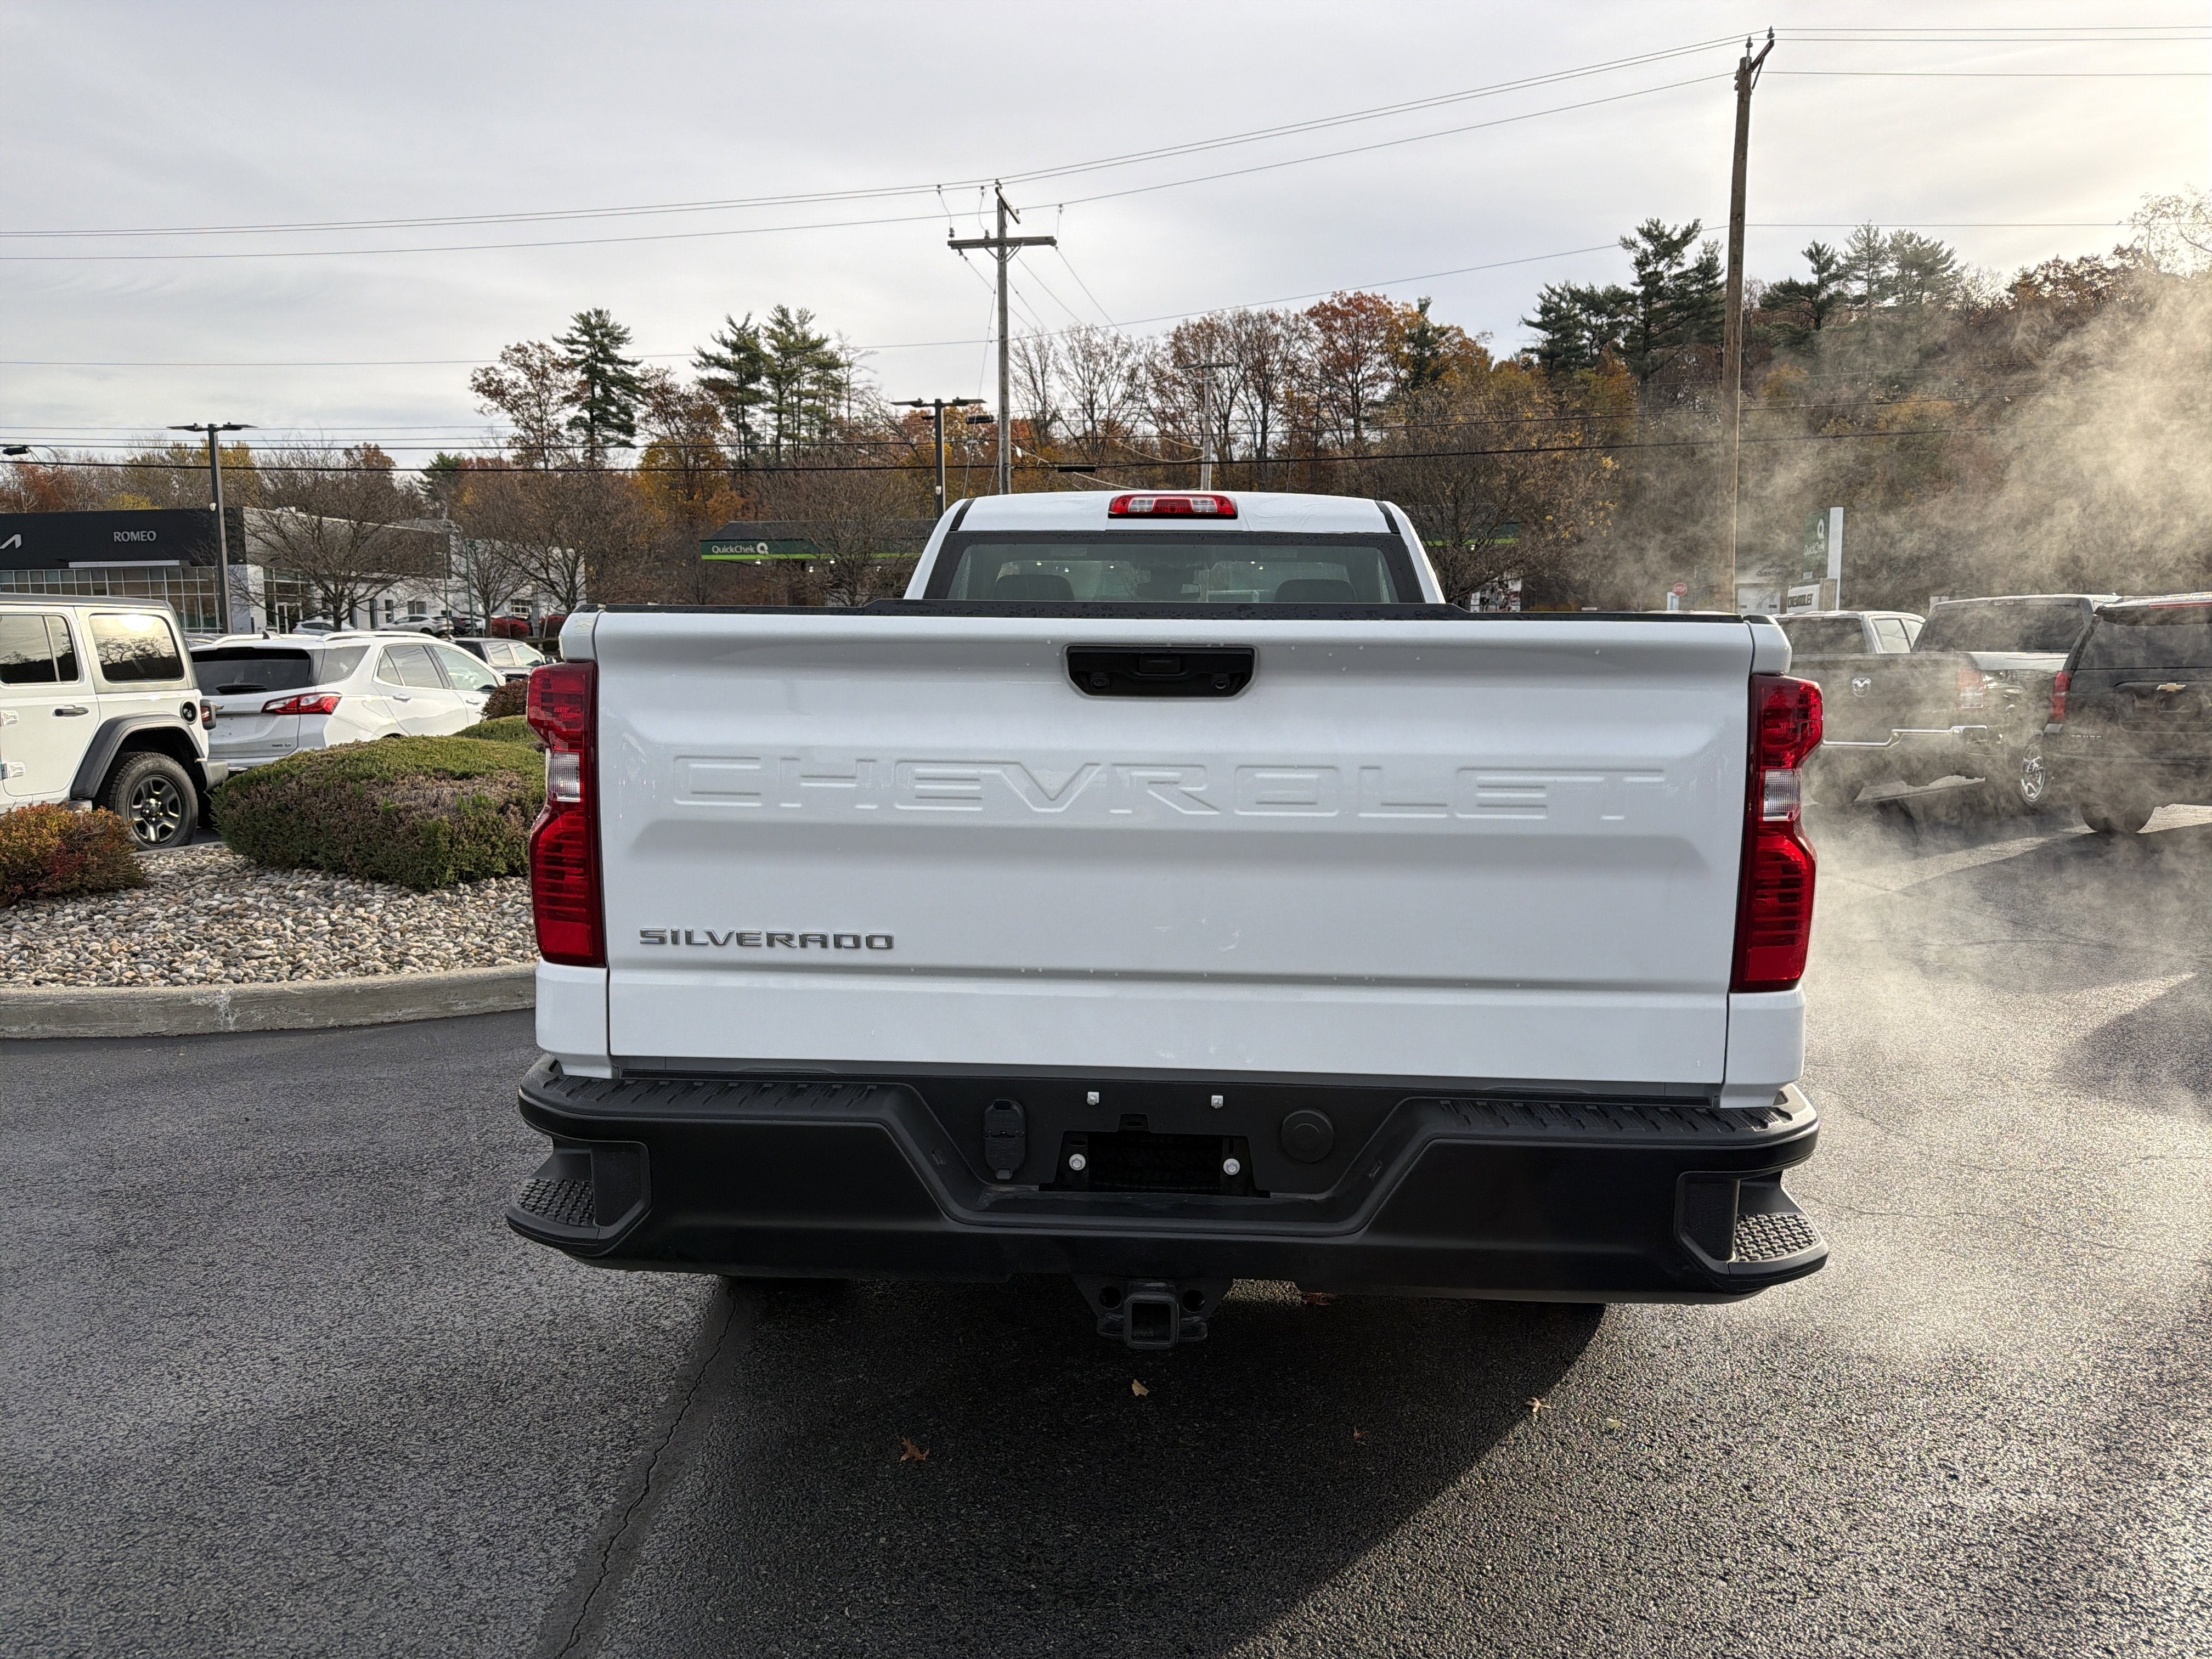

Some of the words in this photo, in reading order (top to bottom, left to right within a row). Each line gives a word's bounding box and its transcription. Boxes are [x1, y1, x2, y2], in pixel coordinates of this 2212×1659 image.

[113, 531, 157, 542] ROMEO
[712, 545, 755, 554] QuickChek
[672, 755, 1666, 821] CHEVROLET
[640, 928, 894, 949] SILVERADO
